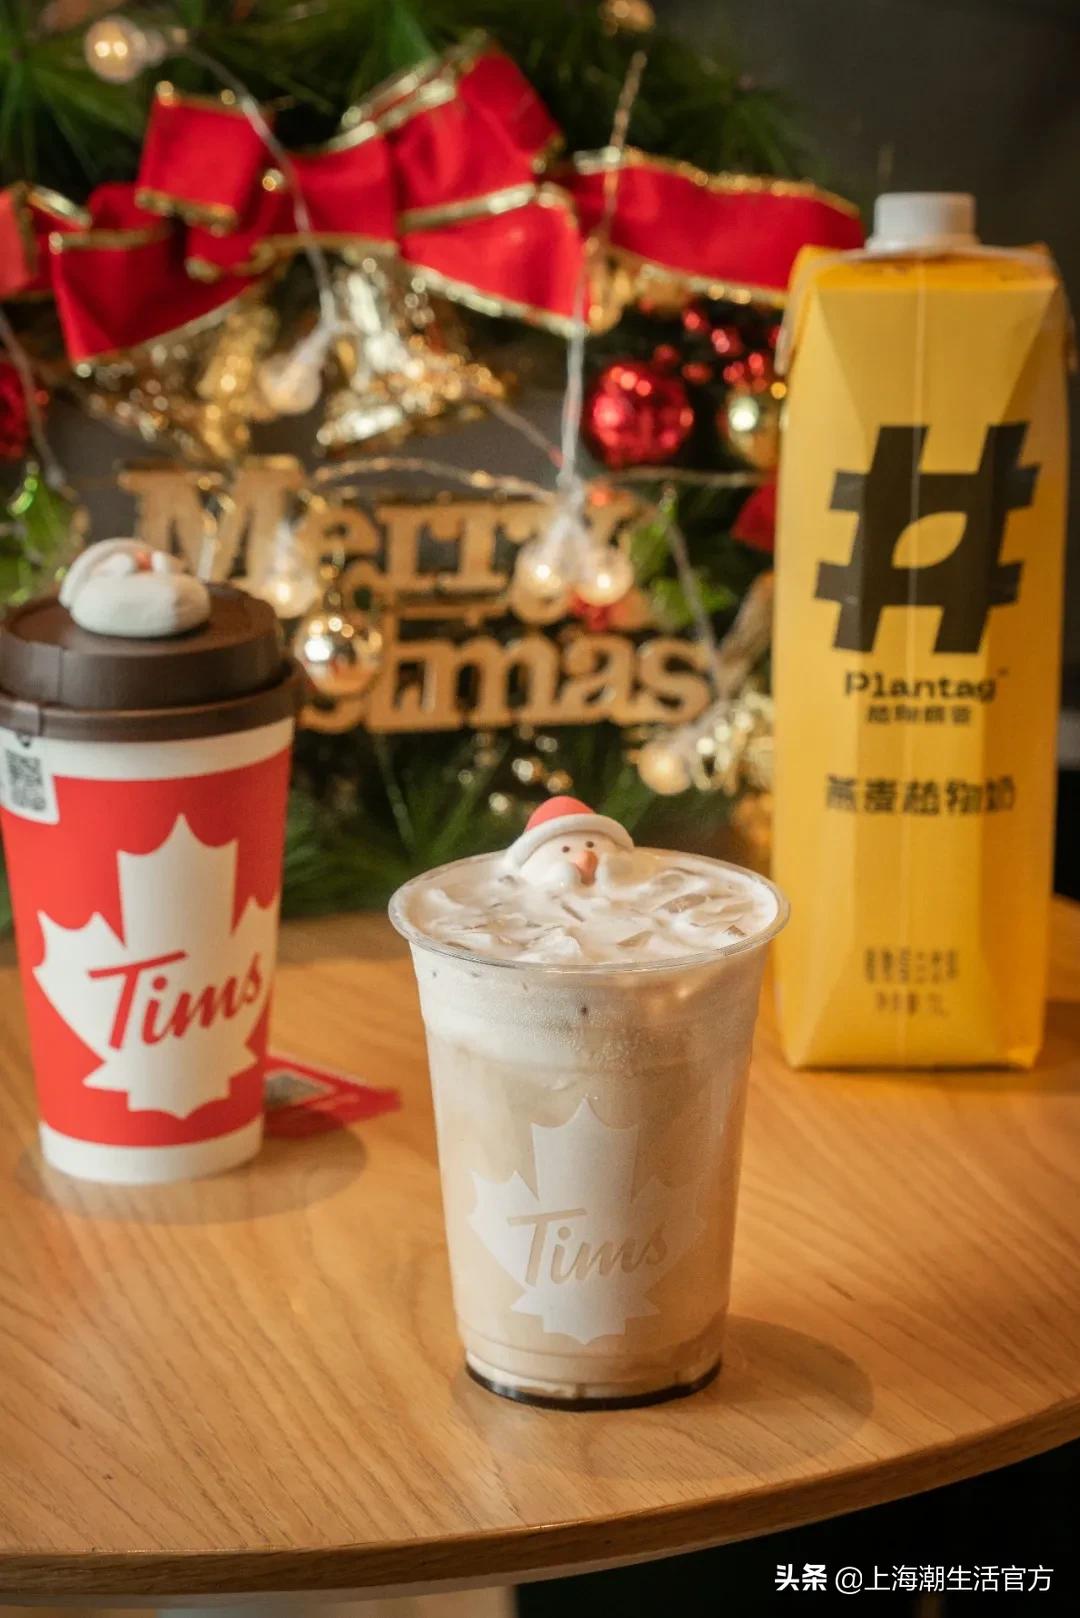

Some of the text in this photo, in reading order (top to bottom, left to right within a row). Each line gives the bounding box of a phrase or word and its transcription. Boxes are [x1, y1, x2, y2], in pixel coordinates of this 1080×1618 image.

[844, 670, 997, 703] Plantag
[87, 950, 263, 1052] Tims
[506, 1207, 668, 1287] Tims
